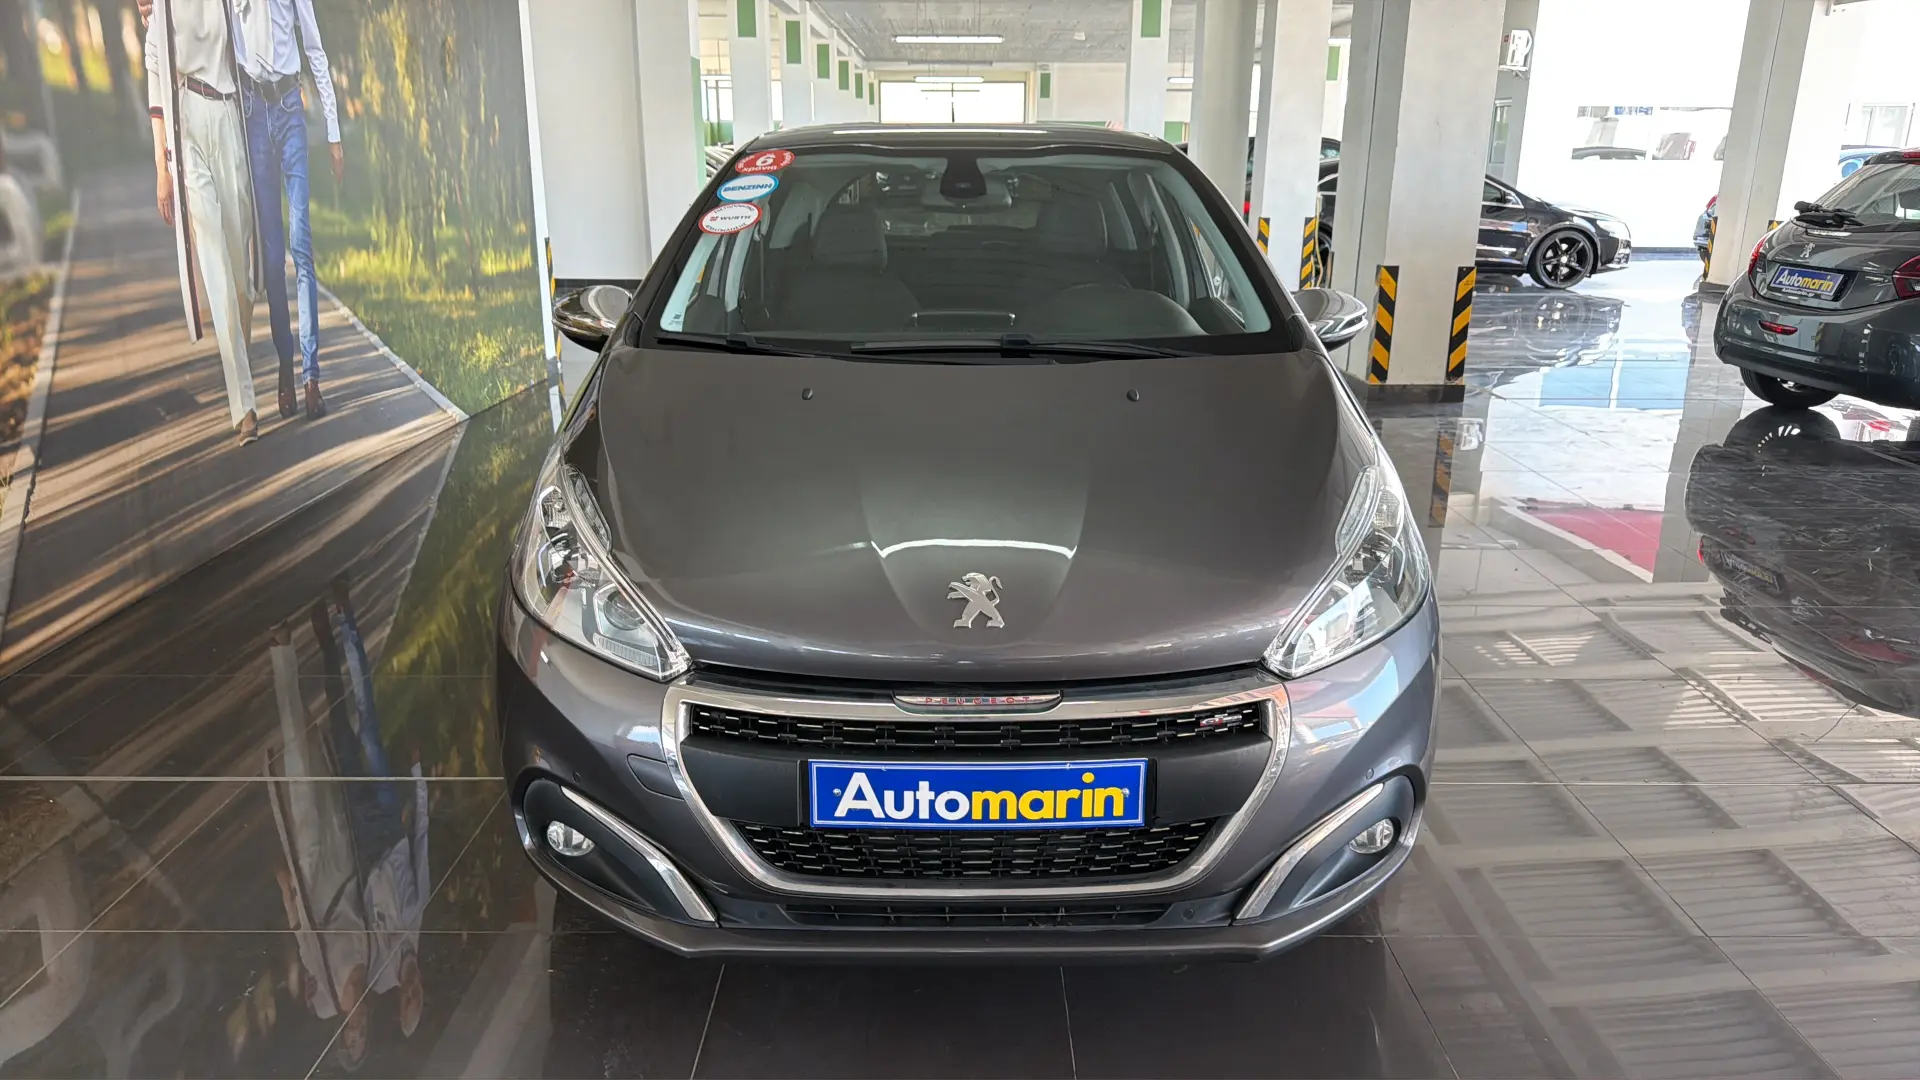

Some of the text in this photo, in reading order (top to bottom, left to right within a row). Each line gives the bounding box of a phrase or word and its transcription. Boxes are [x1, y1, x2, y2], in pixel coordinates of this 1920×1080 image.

[756, 153, 776, 166] 6
[1777, 269, 1834, 291] Automarin
[925, 696, 1030, 705] PEUGEOT
[834, 771, 1125, 820] Automarin
